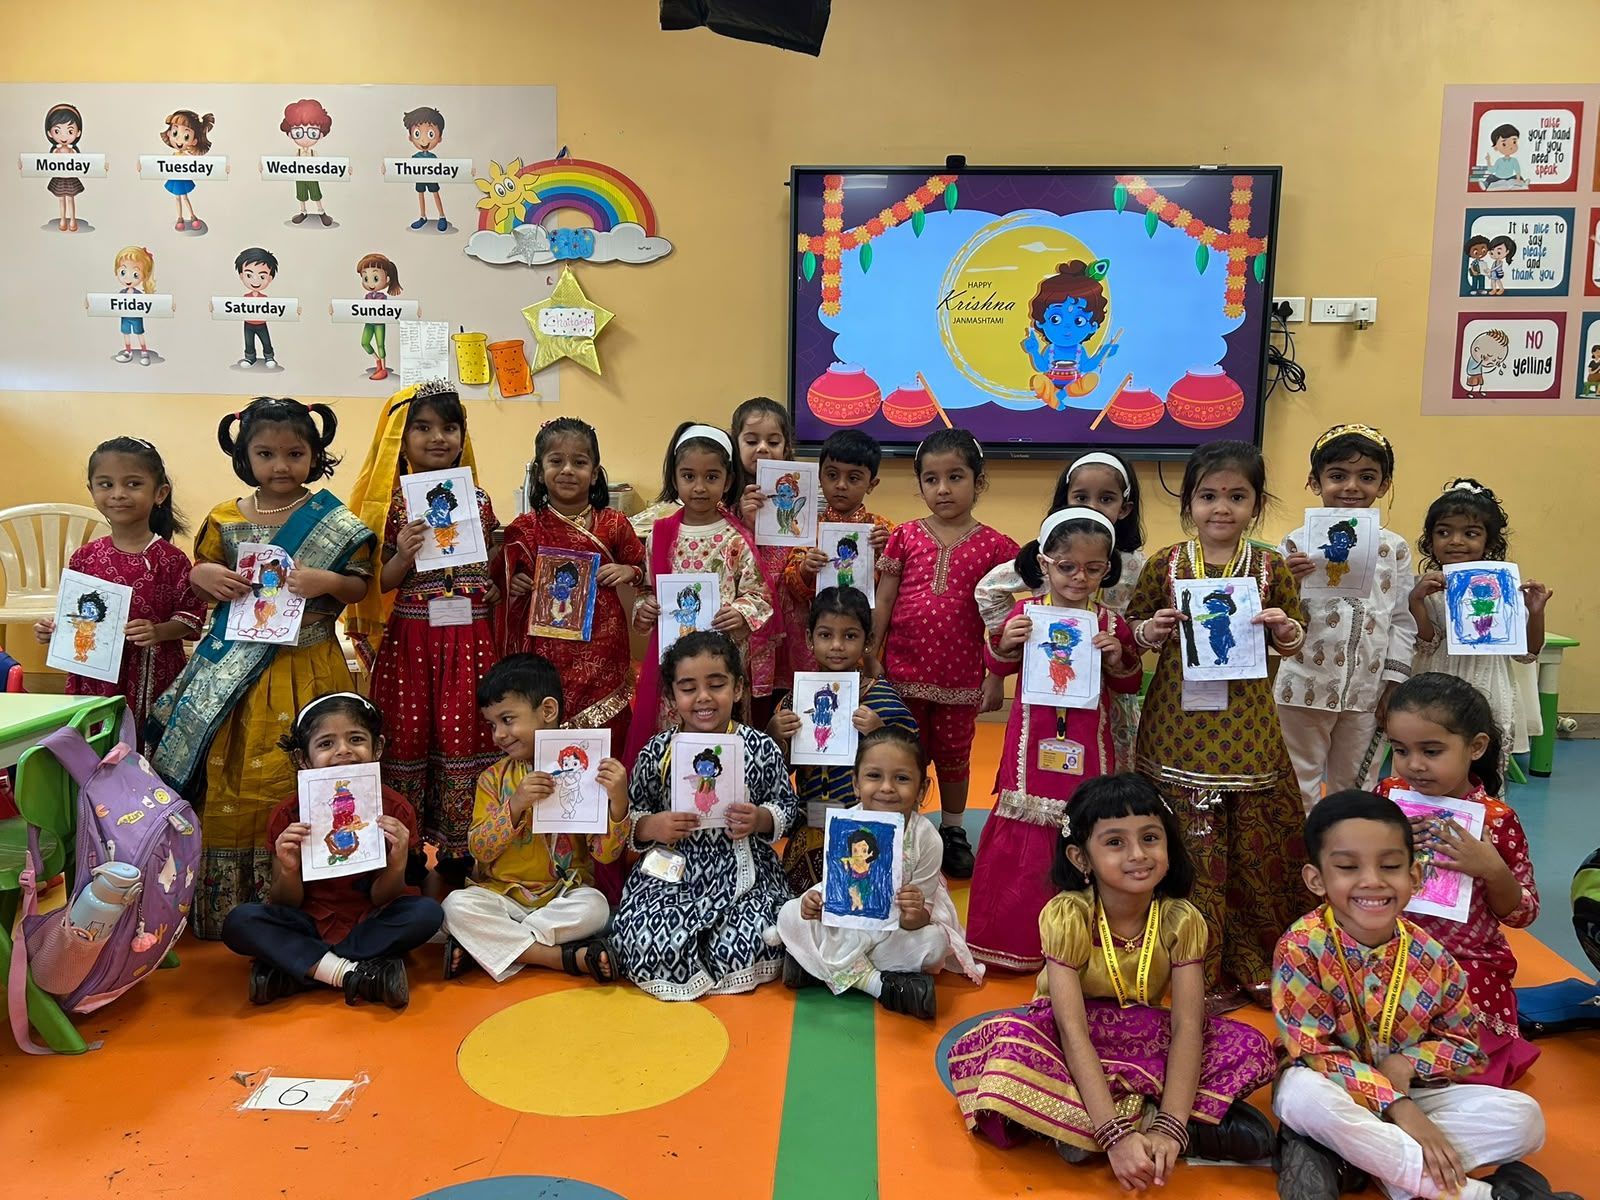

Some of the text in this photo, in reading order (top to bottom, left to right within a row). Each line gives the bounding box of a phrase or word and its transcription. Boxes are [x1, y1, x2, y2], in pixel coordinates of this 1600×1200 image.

[1540, 117, 1560, 129] raise
[1528, 128, 1571, 141] your hand
[1534, 141, 1562, 153] if you
[1531, 152, 1564, 164] need to
[36, 158, 91, 174] Monday
[157, 160, 213, 176] Tuesday
[266, 161, 347, 177] Wednesday
[394, 162, 459, 178] Thursday
[1535, 164, 1558, 178] speak
[1508, 222, 1565, 234] It is nice to
[1528, 235, 1543, 246] say
[1522, 246, 1547, 260] please
[1526, 258, 1541, 269] and
[1511, 268, 1555, 281] thank you
[967, 281, 992, 289] HAPPY
[110, 298, 152, 313] Friday
[936, 289, 1016, 311] Krishna
[224, 301, 286, 317] Saturday
[351, 303, 402, 319] Sunday
[952, 317, 1004, 325] JANMASHTAMI
[1525, 330, 1543, 349] NO
[1512, 356, 1552, 377] yelling
[278, 1080, 316, 1106] 6
